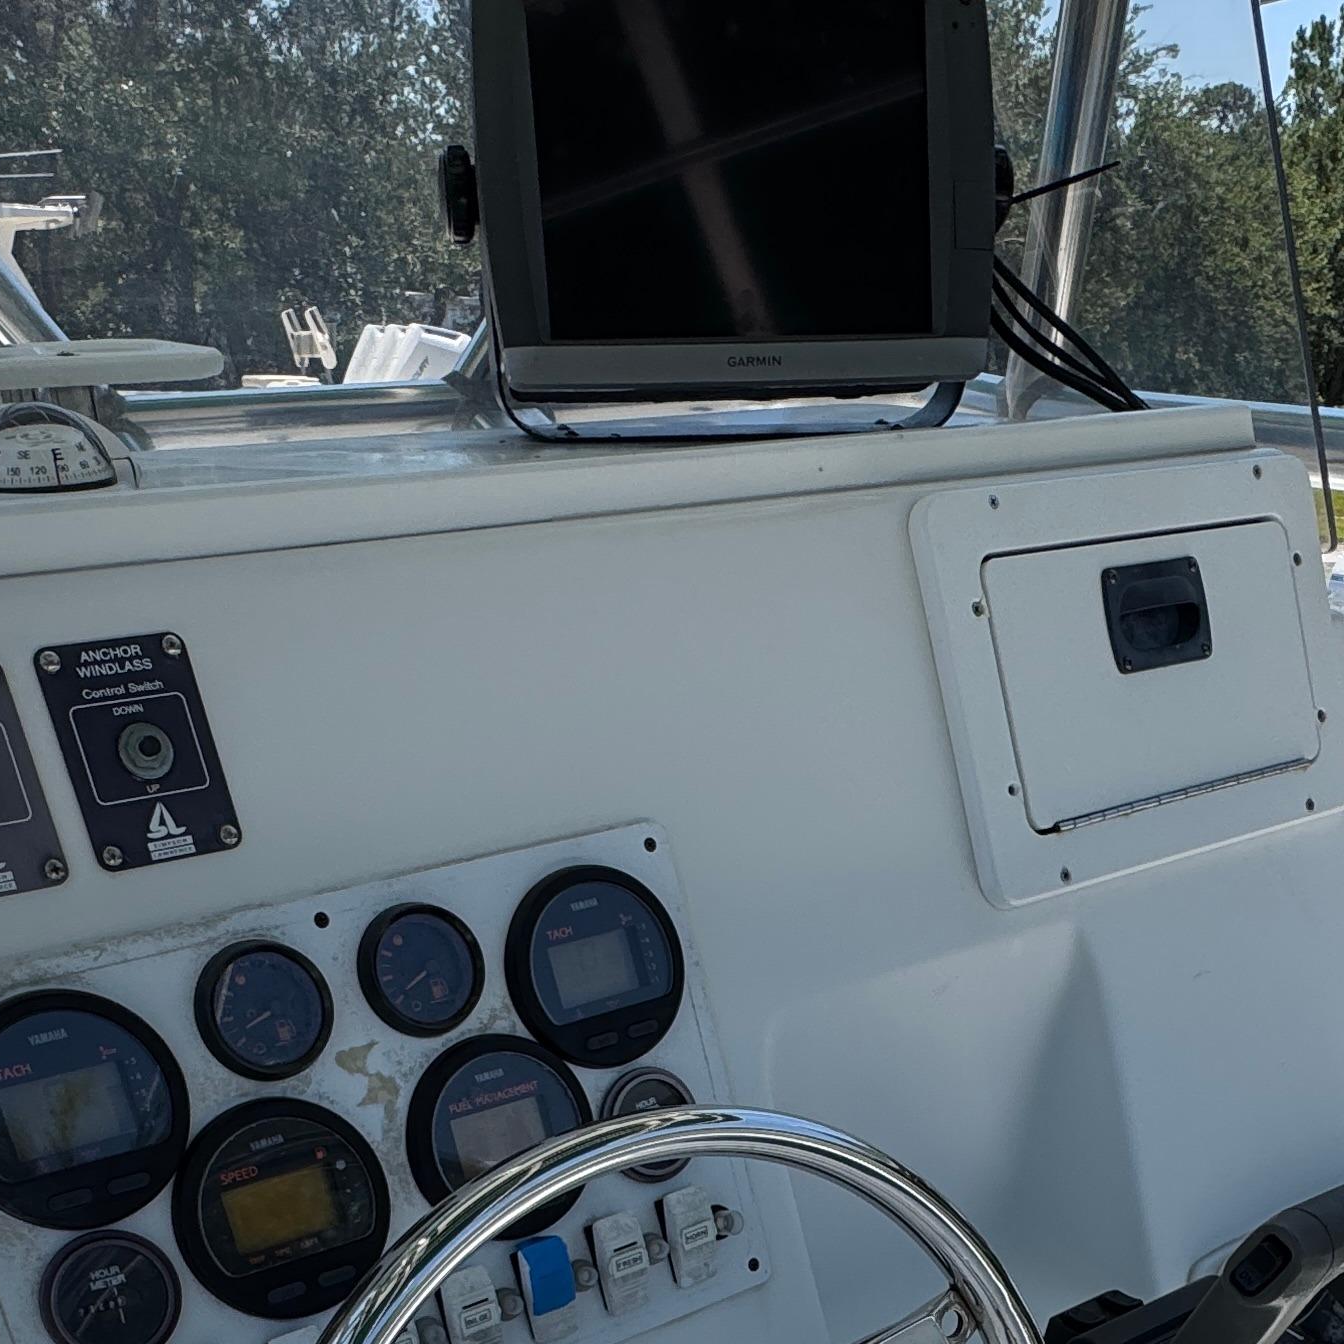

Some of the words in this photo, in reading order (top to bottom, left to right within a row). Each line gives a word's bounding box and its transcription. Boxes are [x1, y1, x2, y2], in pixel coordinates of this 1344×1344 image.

[727, 355, 782, 368] GARMIN
[17, 450, 31, 460] SE
[52, 448, 64, 461] E
[7, 467, 21, 477] 150
[30, 466, 47, 476] 120
[80, 644, 142, 663] ANCHOR
[76, 658, 153, 679] WINDLASS
[82, 684, 126, 699] Control
[128, 680, 164, 693] Switch
[112, 703, 144, 716] DOWN
[146, 784, 161, 793] UP
[546, 925, 573, 942] TACH
[27, 1028, 70, 1047] YAMAHA
[448, 1097, 473, 1115] FUEL
[635, 1096, 657, 1110] HOUR
[220, 1165, 258, 1185] SPEED
[89, 1264, 121, 1281] HOUR
[90, 1273, 127, 1291] METER
